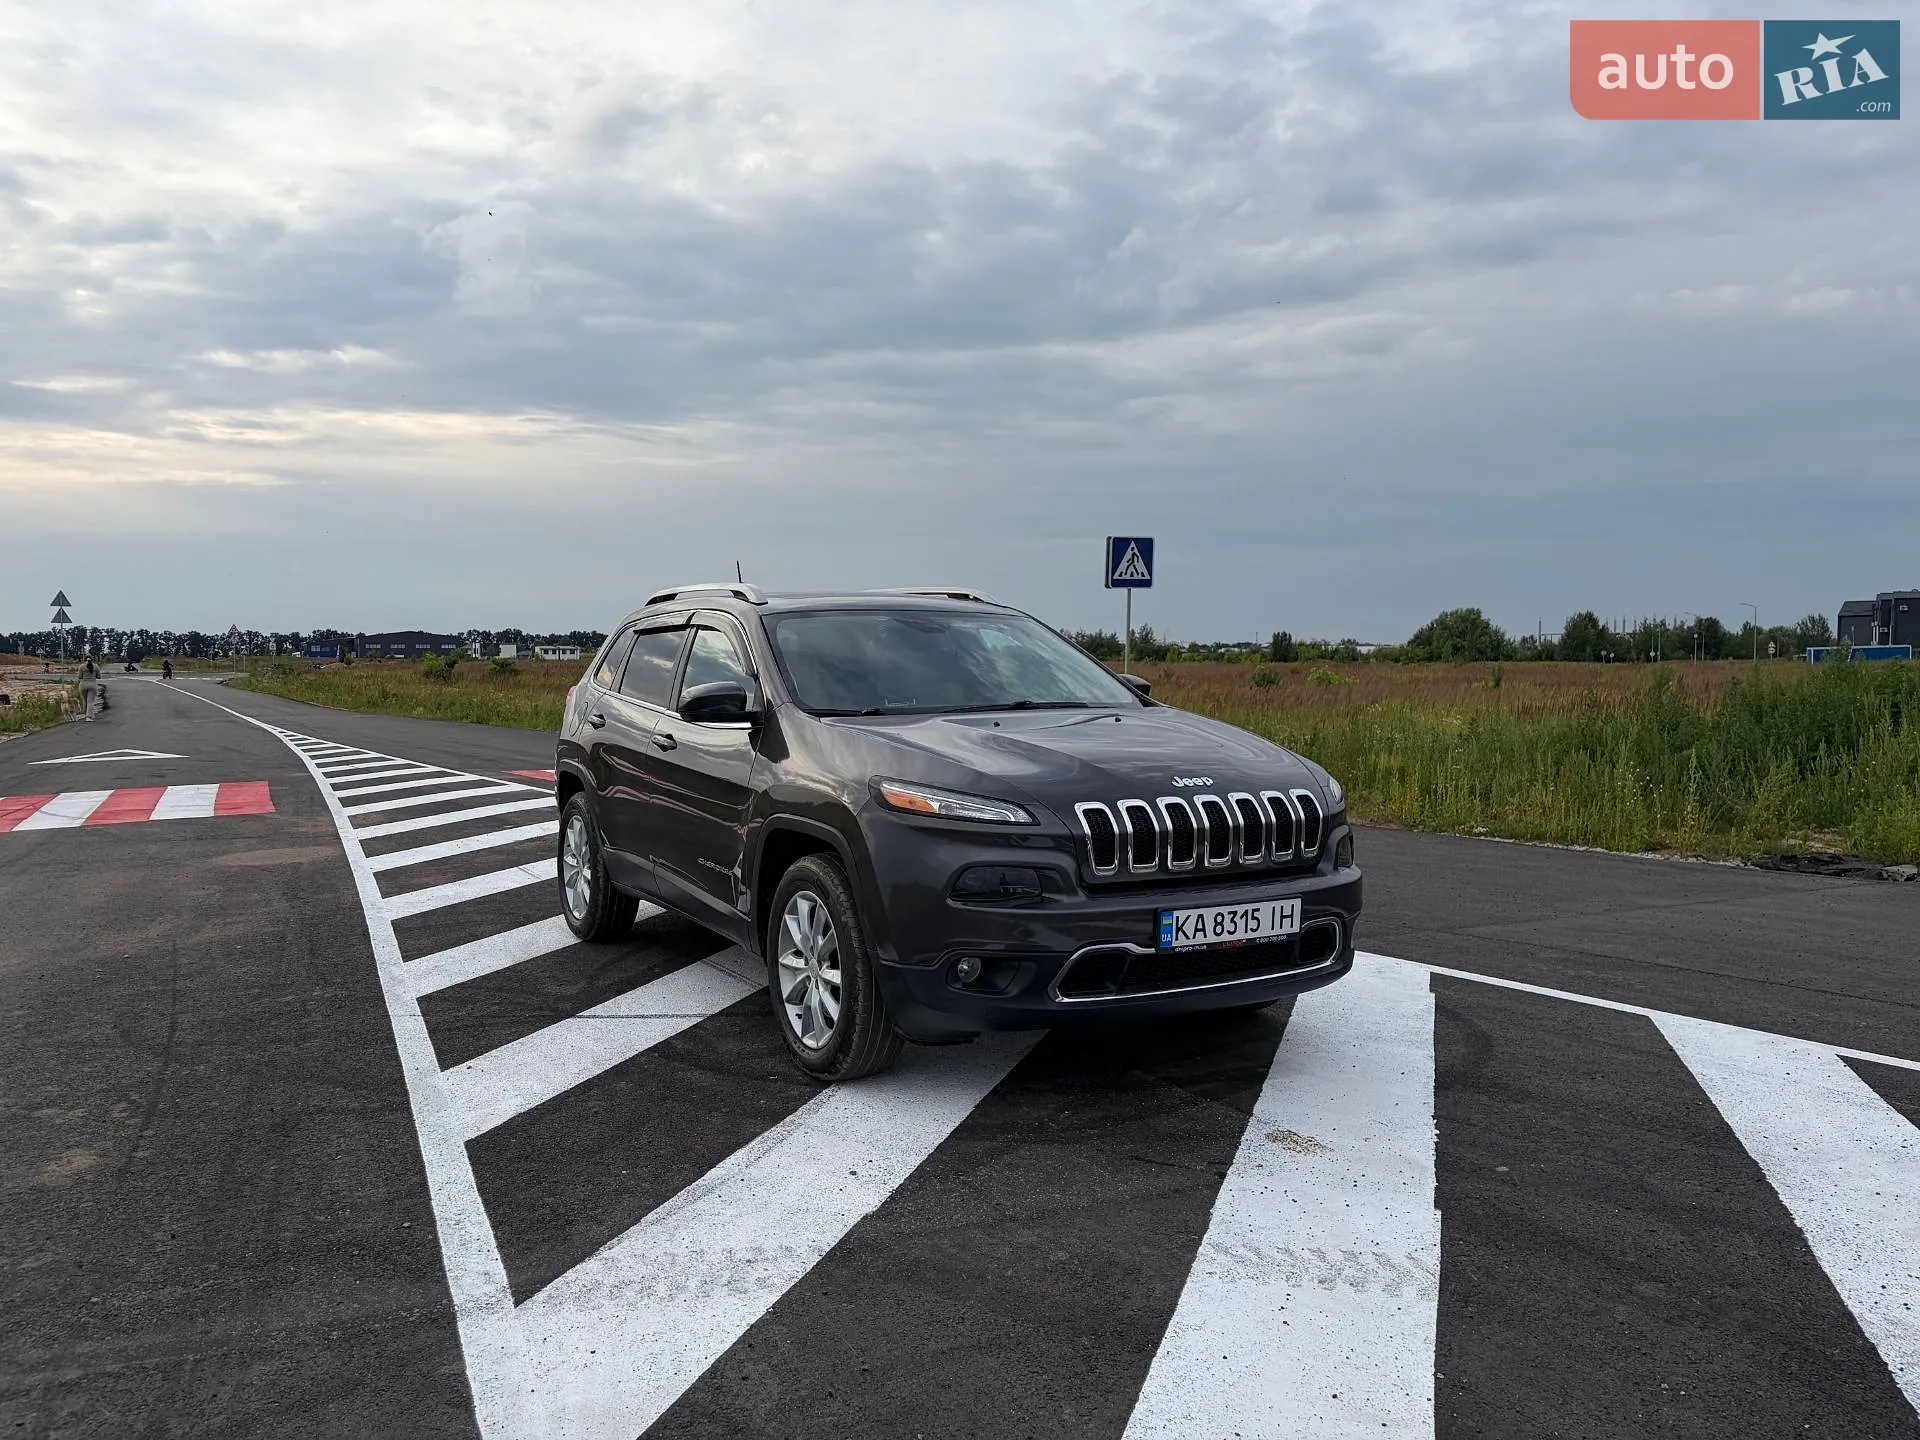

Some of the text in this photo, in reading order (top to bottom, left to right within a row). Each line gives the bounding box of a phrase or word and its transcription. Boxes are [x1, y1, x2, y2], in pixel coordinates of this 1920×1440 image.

[1171, 776, 1214, 787] Jeep
[1175, 903, 1295, 941] KA 8315 IH
[1161, 934, 1172, 942] UA
